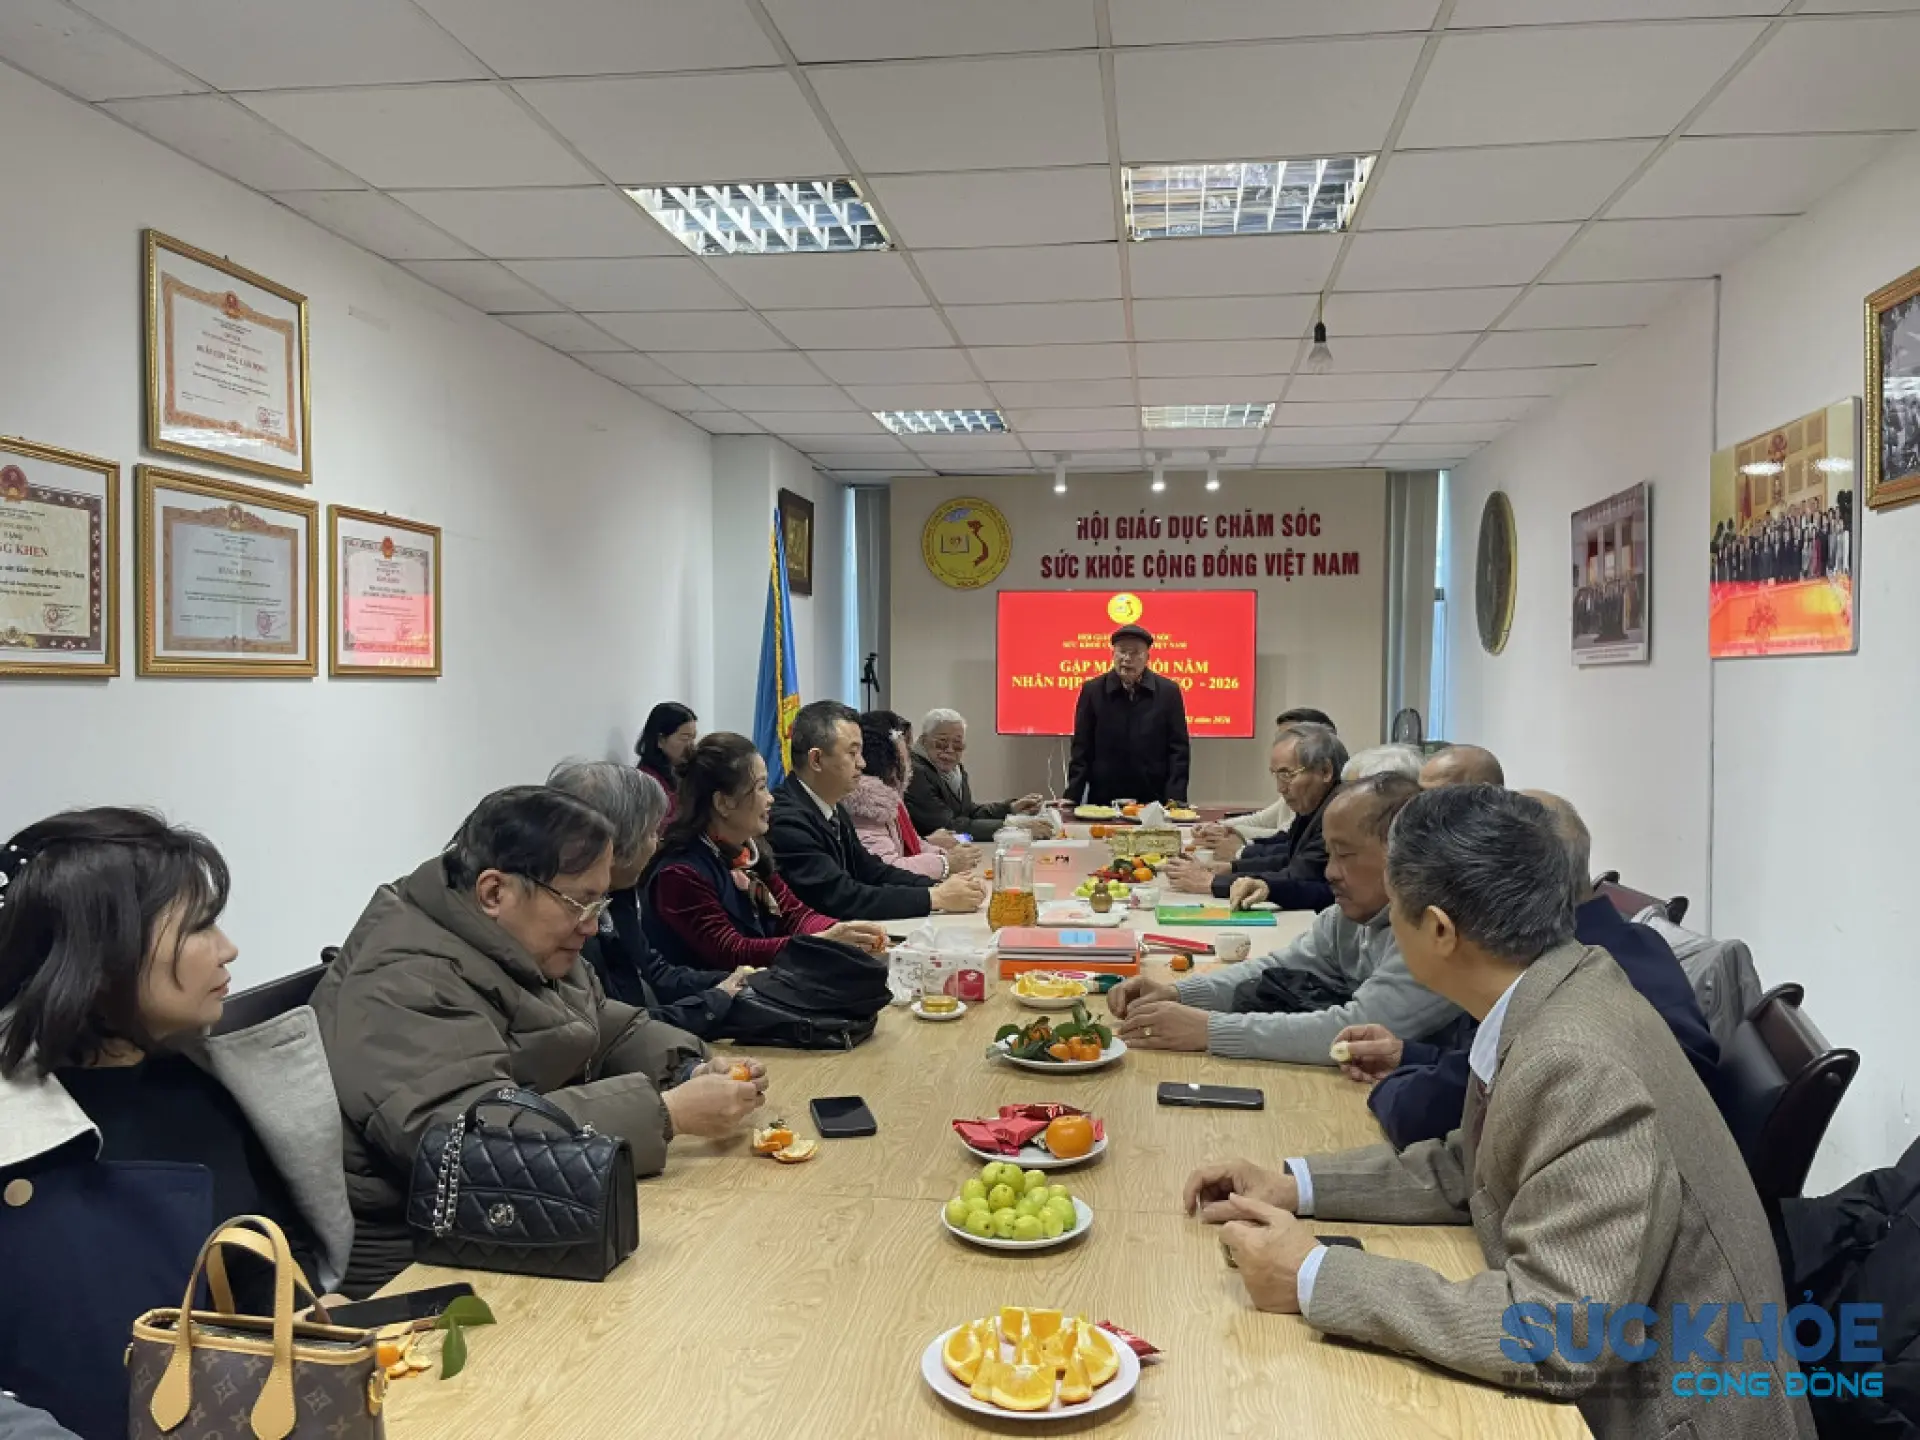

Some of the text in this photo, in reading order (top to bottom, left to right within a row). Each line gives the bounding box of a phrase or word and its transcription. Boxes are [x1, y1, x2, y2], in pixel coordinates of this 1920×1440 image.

[1077, 506, 1321, 546] HỘI GIÁO DỤC CHĂM SÓC
[1041, 549, 1079, 579] SỨC
[1086, 545, 1135, 578] KHỎE
[1143, 549, 1196, 584] CỘNG
[1265, 548, 1305, 582] VIỆT
[1313, 551, 1359, 576] NAM
[1060, 659, 1091, 675] GẶP
[1173, 658, 1209, 674] NĂM
[1012, 673, 1054, 688] NHÂN
[1058, 676, 1082, 690] DỊP
[1208, 676, 1239, 690] 2026
